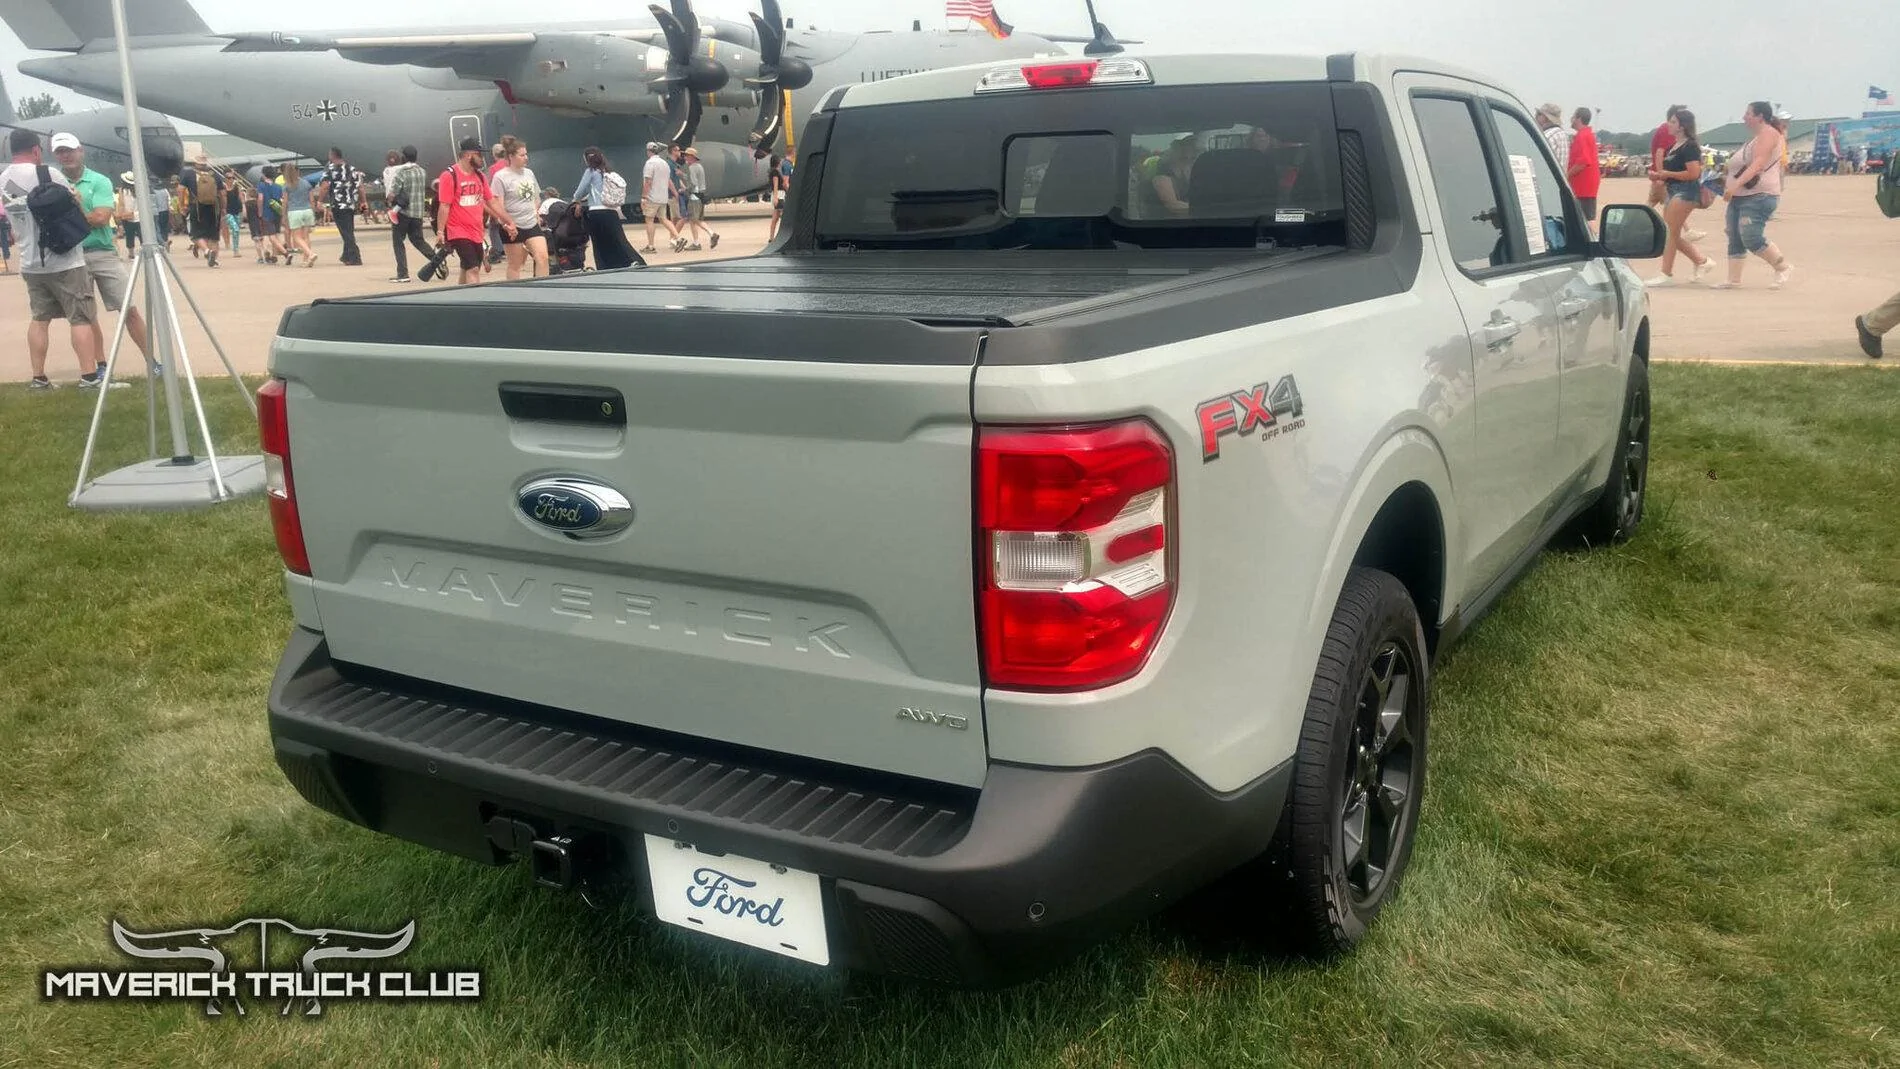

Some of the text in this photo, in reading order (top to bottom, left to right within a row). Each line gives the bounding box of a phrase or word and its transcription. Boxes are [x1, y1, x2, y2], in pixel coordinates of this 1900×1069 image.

[292, 101, 362, 120] 54 06
[1195, 373, 1303, 465] FX4
[1261, 419, 1306, 442] OFF ROAD
[534, 493, 581, 522] Ford
[380, 556, 851, 659] MAVERICK
[896, 707, 968, 731] AWD
[686, 867, 784, 927] Ford
